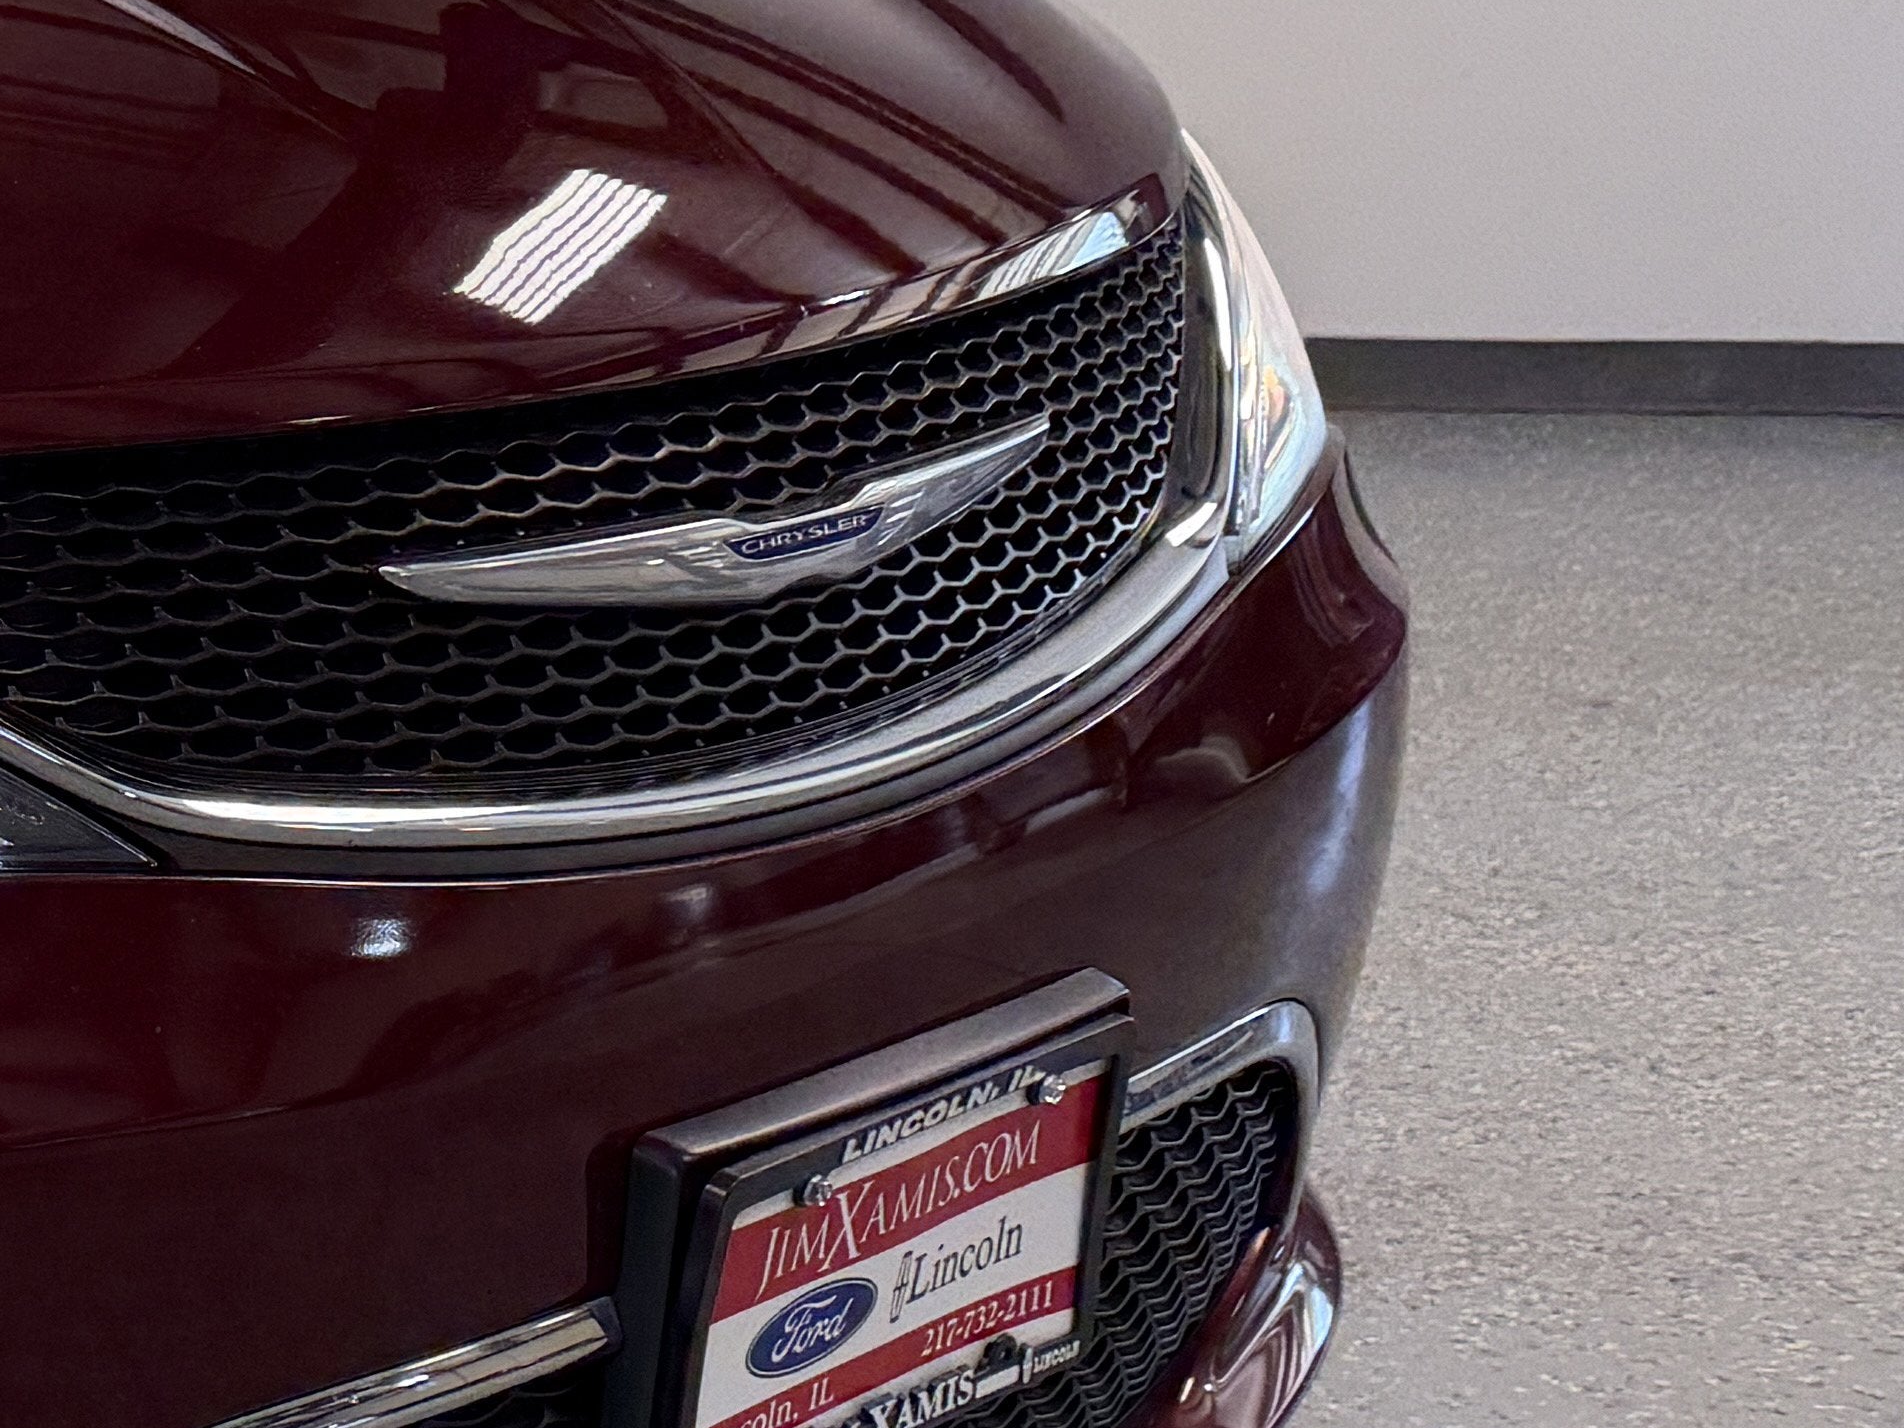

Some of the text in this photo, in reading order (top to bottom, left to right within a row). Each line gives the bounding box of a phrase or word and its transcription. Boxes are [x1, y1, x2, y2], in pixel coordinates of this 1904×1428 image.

[741, 514, 867, 554] CHRYSLER
[842, 1080, 999, 1164] LINCOLN,
[905, 1215, 1024, 1306] Lincoln
[770, 1294, 854, 1364] Ford
[921, 1280, 1055, 1359] 217-732-2111
[808, 1378, 835, 1411] IL
